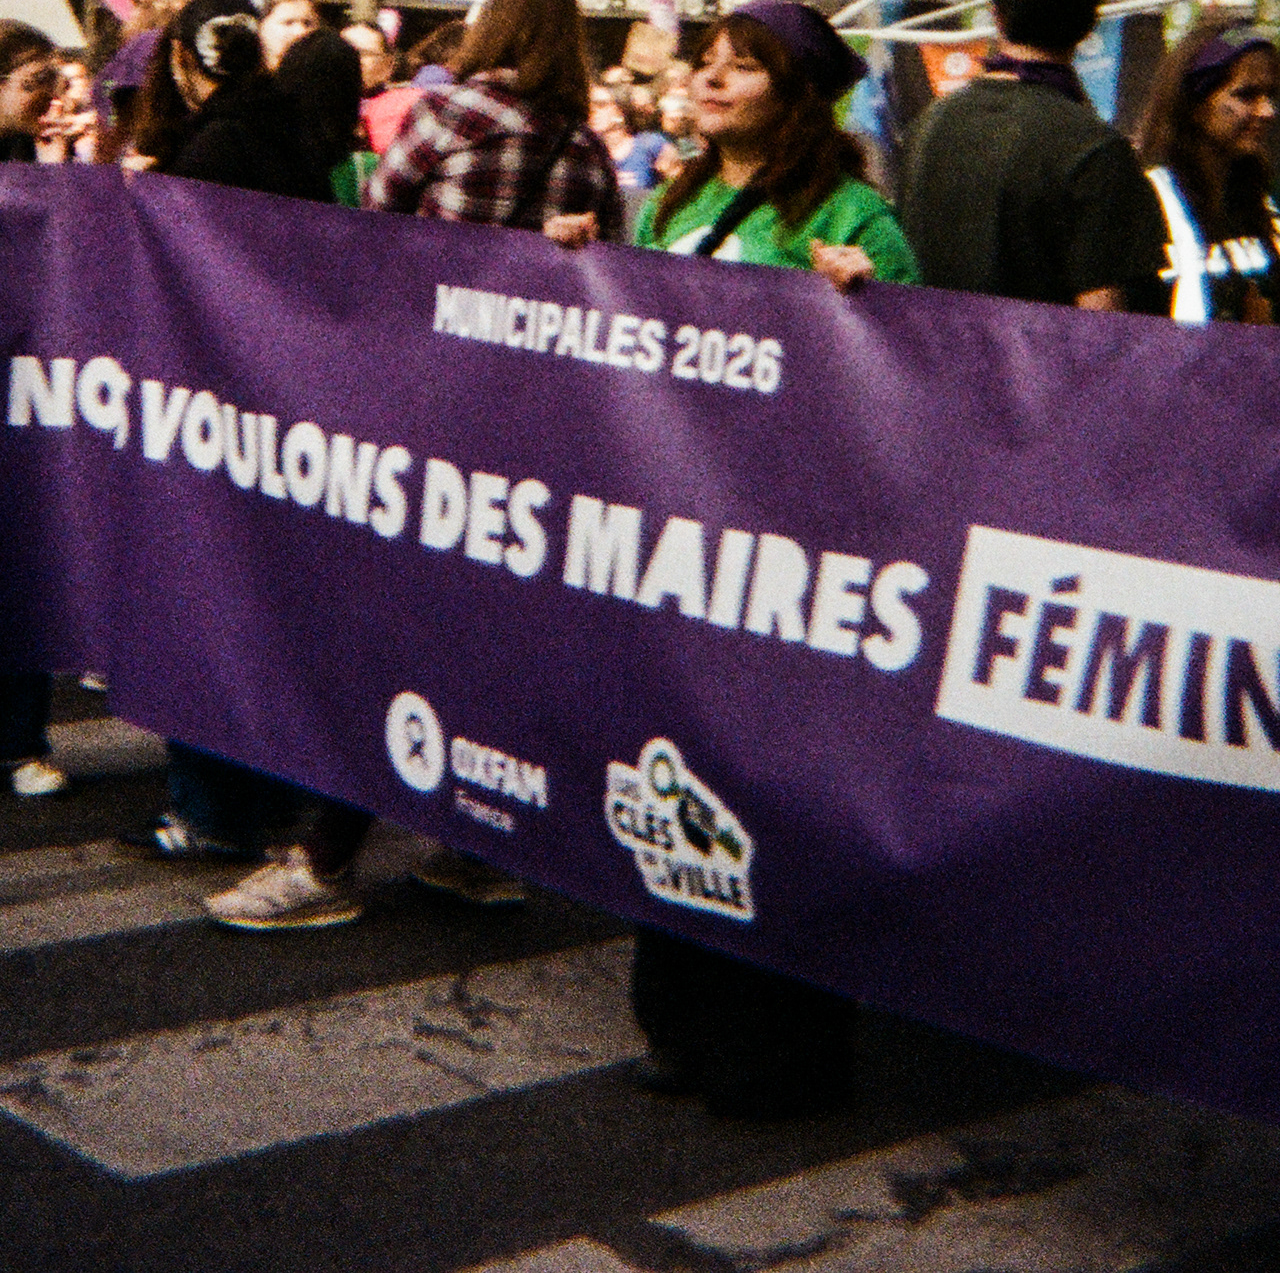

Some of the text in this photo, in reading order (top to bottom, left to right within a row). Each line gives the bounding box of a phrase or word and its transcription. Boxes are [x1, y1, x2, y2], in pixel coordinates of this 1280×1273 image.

[433, 284, 783, 394] MUNICIPALES 2026
[140, 379, 413, 539] VOULONS
[419, 458, 551, 578] DES
[562, 494, 930, 672] MAIRES
[450, 736, 548, 808] OXFAM
